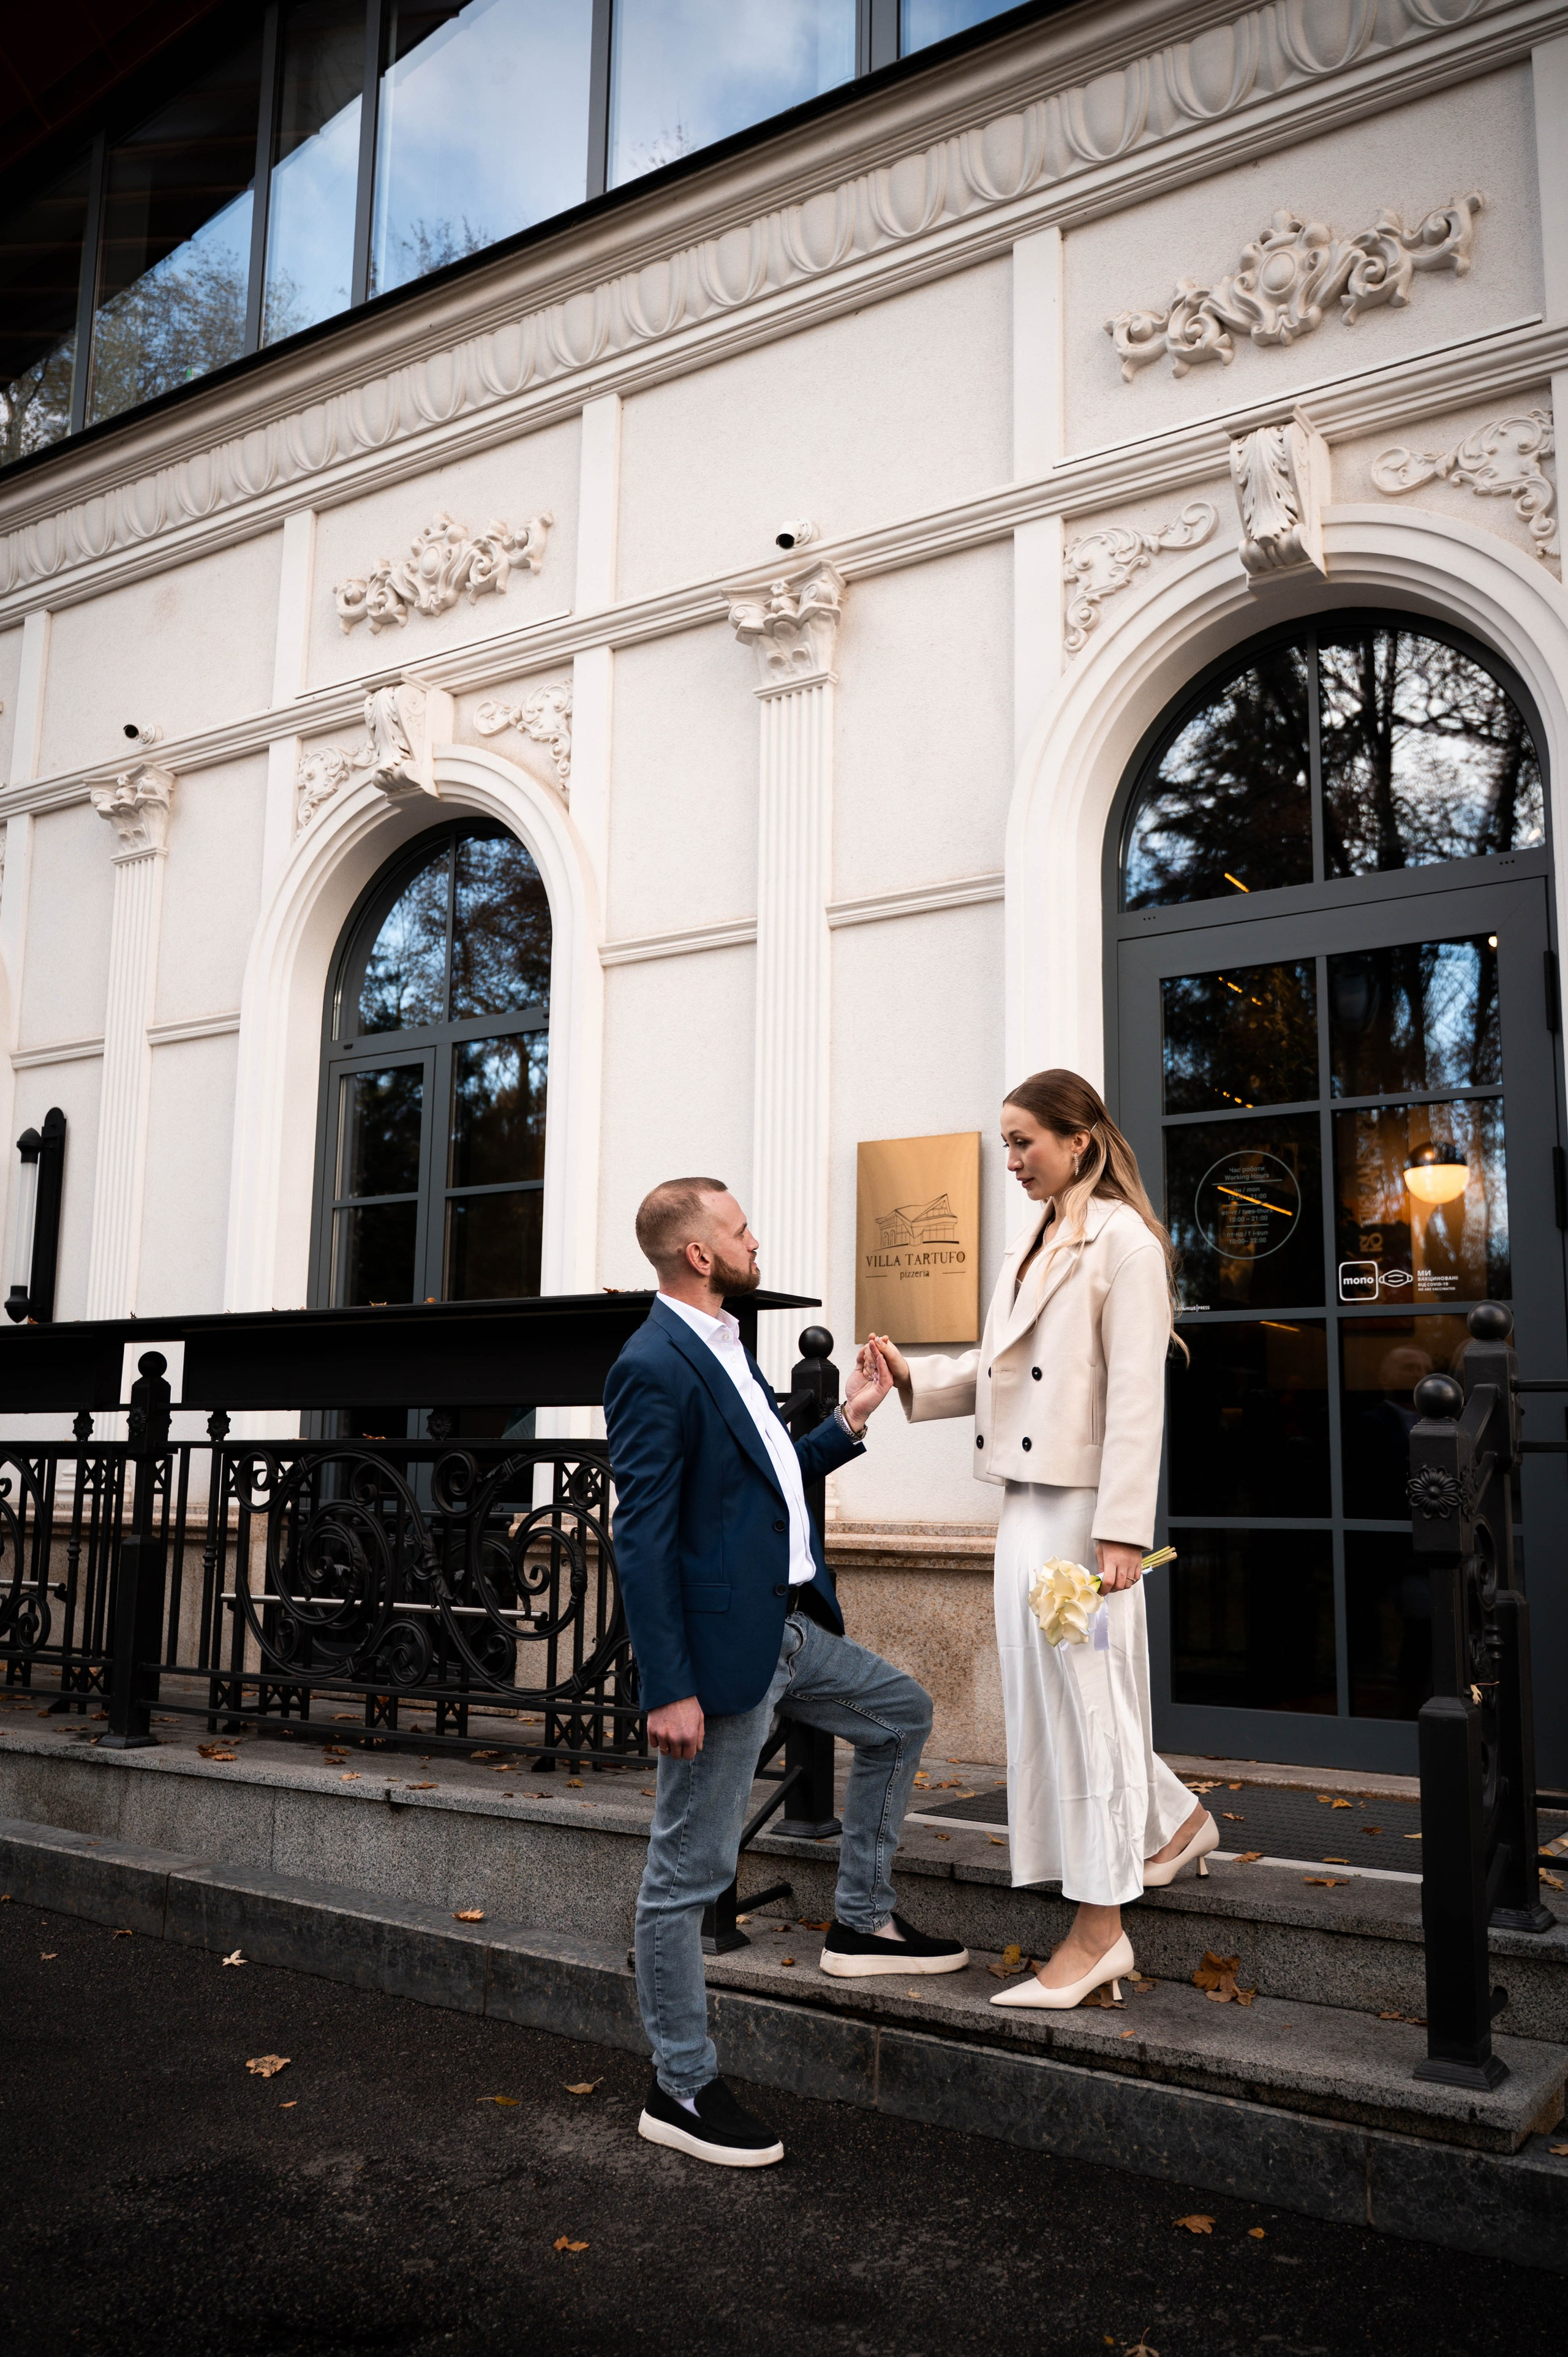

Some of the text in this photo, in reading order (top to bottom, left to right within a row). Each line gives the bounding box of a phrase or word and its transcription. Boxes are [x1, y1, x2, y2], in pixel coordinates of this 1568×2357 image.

[866, 1251, 966, 1267] VILLA TARTUFO
[900, 1269, 930, 1280] pizzeria
[1343, 1277, 1374, 1285] mono
